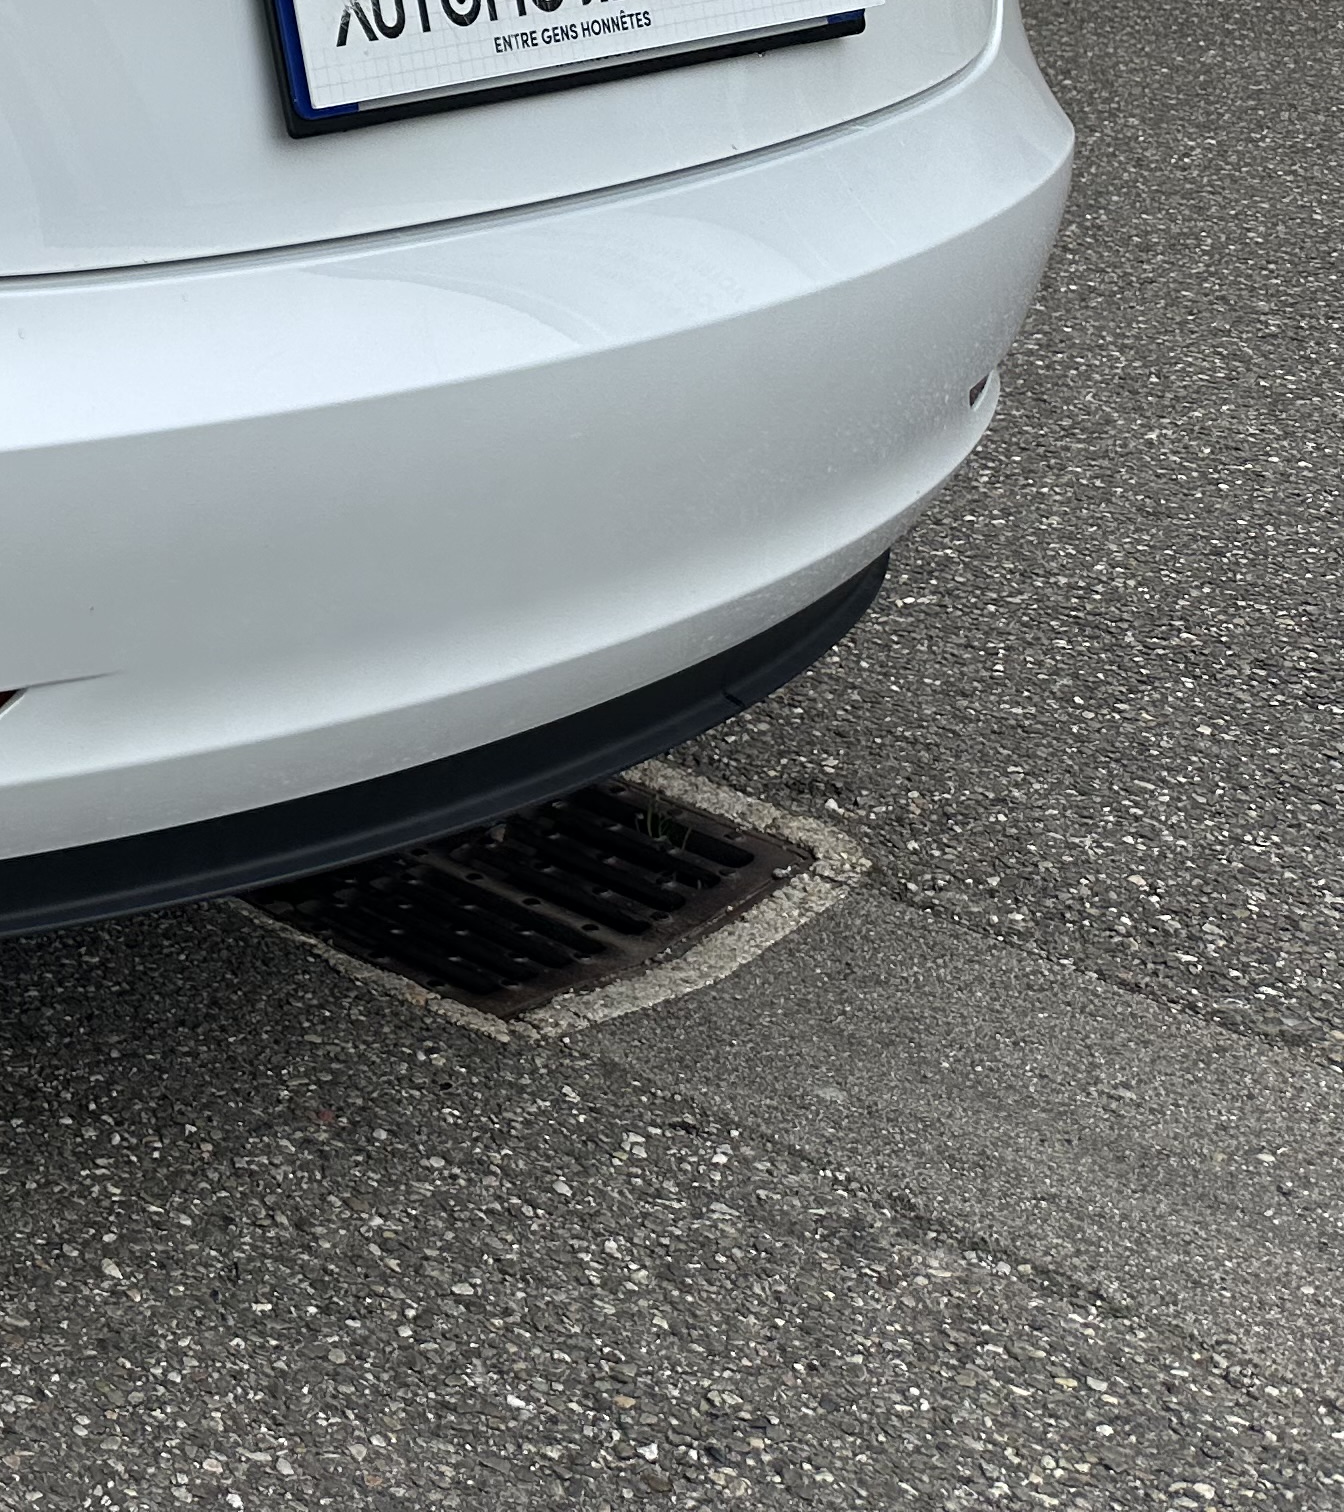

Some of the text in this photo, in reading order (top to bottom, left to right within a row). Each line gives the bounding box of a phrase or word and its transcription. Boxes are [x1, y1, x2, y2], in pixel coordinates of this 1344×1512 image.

[494, 9, 652, 54] ENTRE GENS HONNÊTES
